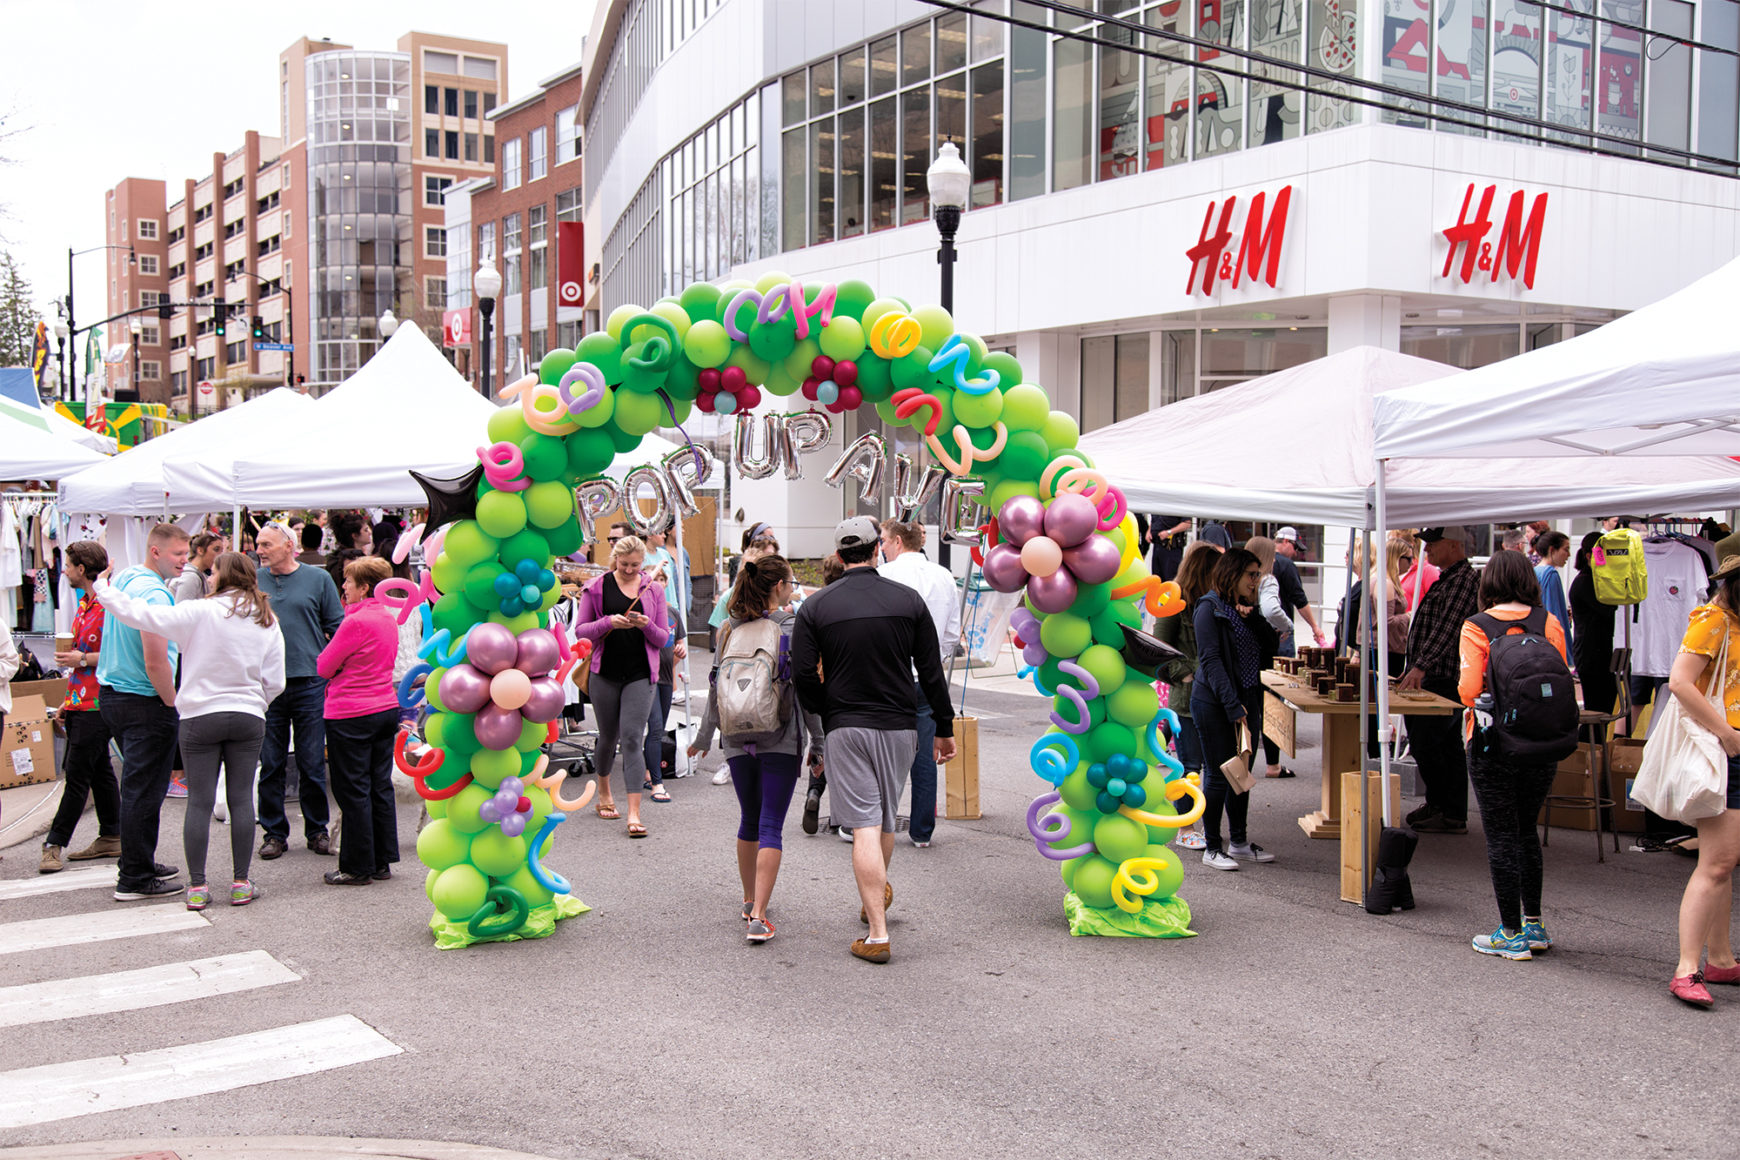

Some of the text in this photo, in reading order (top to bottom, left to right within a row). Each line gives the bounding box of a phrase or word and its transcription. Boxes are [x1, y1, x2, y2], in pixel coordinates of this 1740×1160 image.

[1186, 185, 1292, 296] H&M
[1442, 183, 1549, 290] H&M
[572, 408, 987, 547] POP UP AVE
